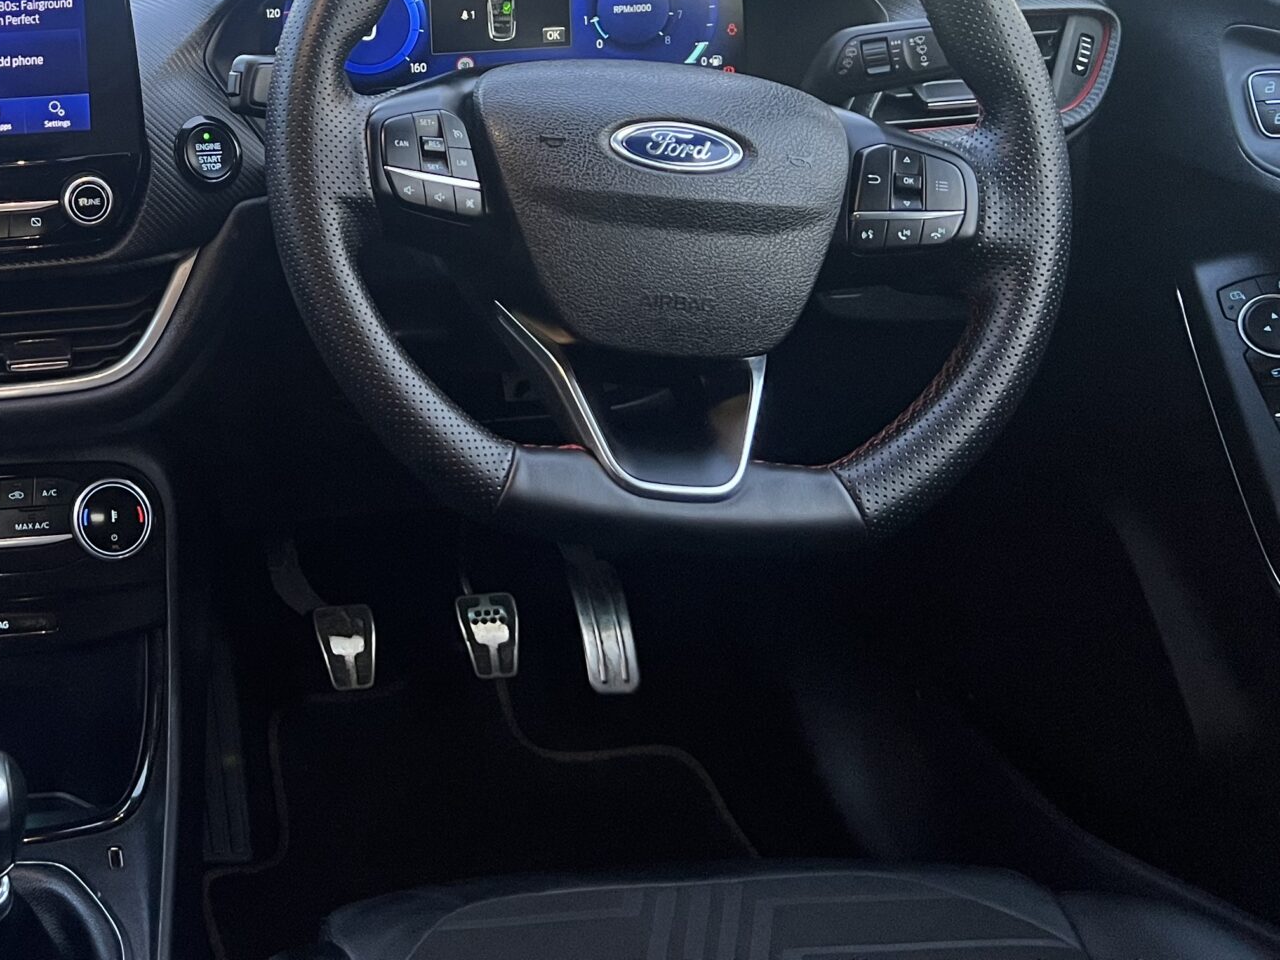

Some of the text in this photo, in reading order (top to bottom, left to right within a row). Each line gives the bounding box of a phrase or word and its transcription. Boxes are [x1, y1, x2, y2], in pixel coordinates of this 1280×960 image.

[266, 8, 281, 19] 120
[613, 3, 652, 14] RPMx1000
[470, 10, 476, 20] 1
[677, 10, 683, 19] 7
[5, 14, 40, 26] Perfect
[546, 30, 560, 40] OK
[664, 35, 671, 45] 8
[596, 39, 603, 49] 0
[12, 55, 44, 69] phone
[700, 56, 708, 66] 0
[410, 62, 428, 73] 160
[44, 119, 71, 129] Settings
[195, 142, 222, 151] ENGINE
[394, 139, 409, 147] CAN
[645, 130, 712, 160] Ford
[198, 155, 222, 164] START
[201, 163, 222, 171] STOP
[42, 489, 58, 497] A/C
[15, 521, 50, 531] MAX A/C
